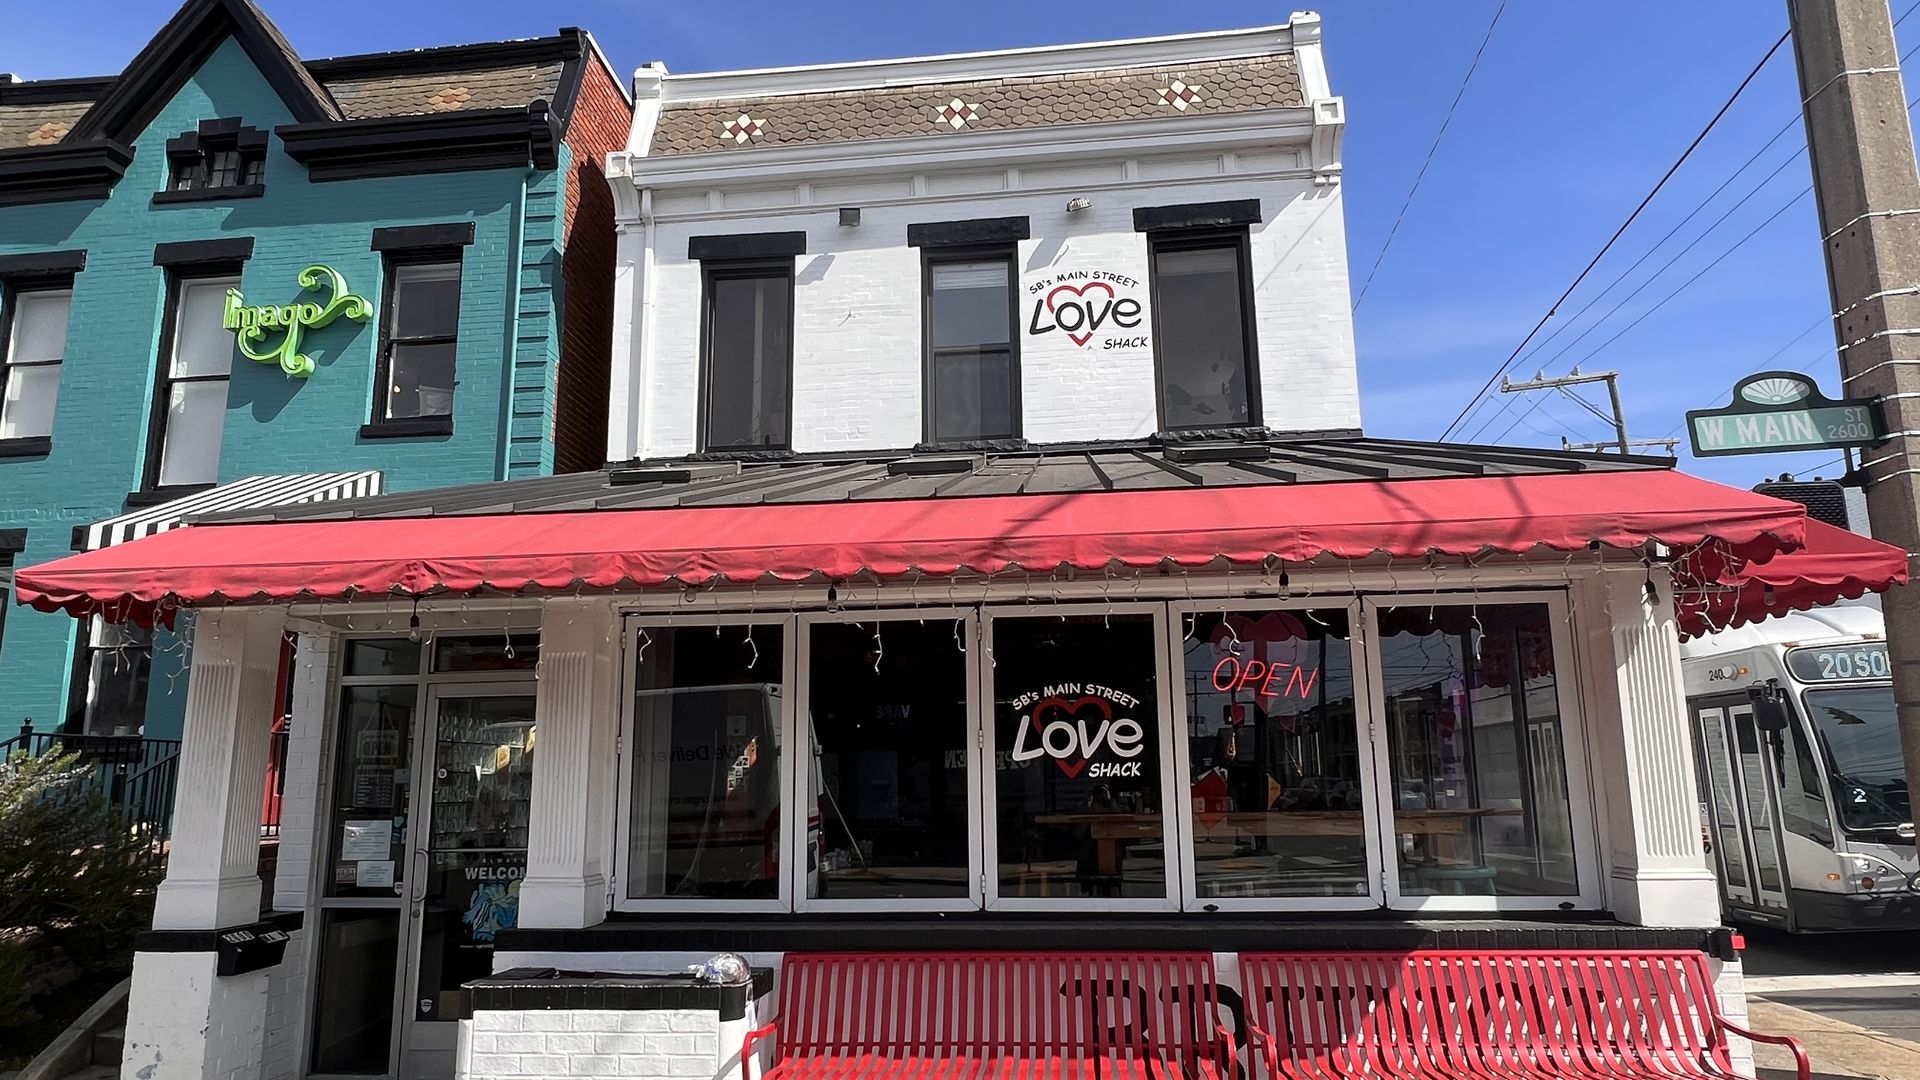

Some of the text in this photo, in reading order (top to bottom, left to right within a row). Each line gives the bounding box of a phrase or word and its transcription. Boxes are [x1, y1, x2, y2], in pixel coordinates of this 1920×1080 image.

[1029, 271, 1140, 295] SB's MAIN STREET
[1103, 336, 1149, 350] SHACK
[1844, 407, 1863, 423] ST
[1701, 412, 1814, 446] W MAIN
[1827, 422, 1869, 440] 2600
[1212, 656, 1319, 700] OPEN
[1012, 683, 1140, 711] SB's MAIN STREET
[1088, 762, 1142, 778] SHACK
